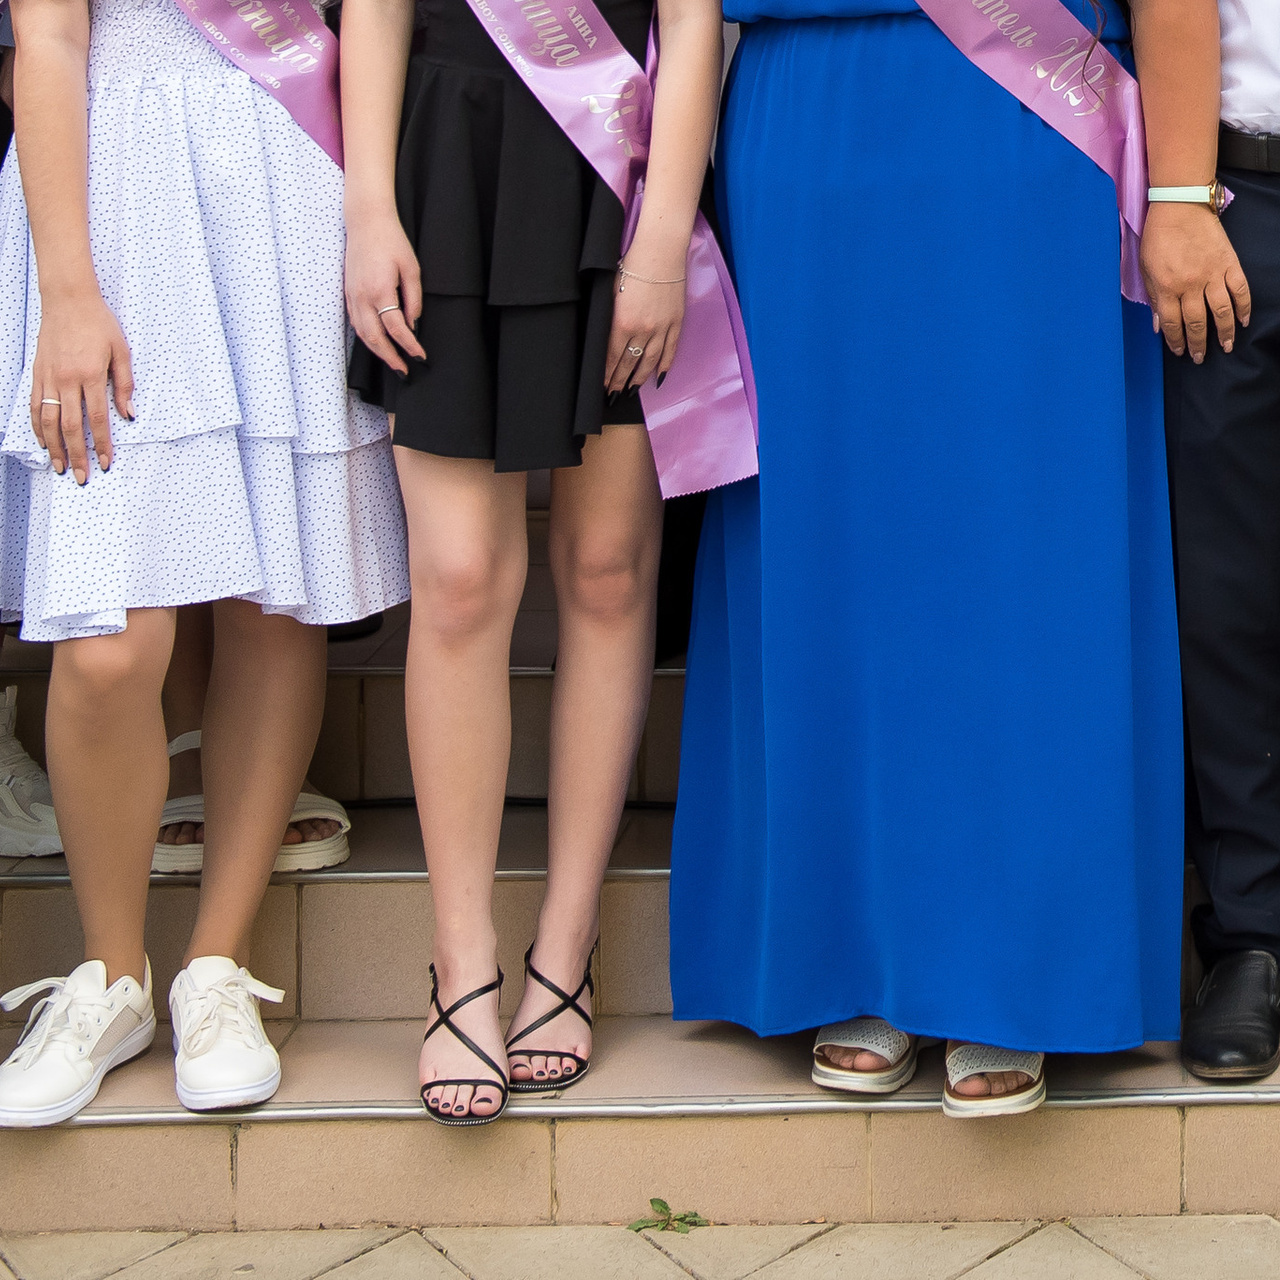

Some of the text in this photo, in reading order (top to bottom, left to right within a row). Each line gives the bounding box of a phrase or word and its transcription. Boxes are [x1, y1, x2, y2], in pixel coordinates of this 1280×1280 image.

[200, 17, 231, 47] МБОУ
[278, 1, 327, 53] МАРИЯ
[493, 25, 517, 57] СОШ
[565, 5, 599, 51] АННА
